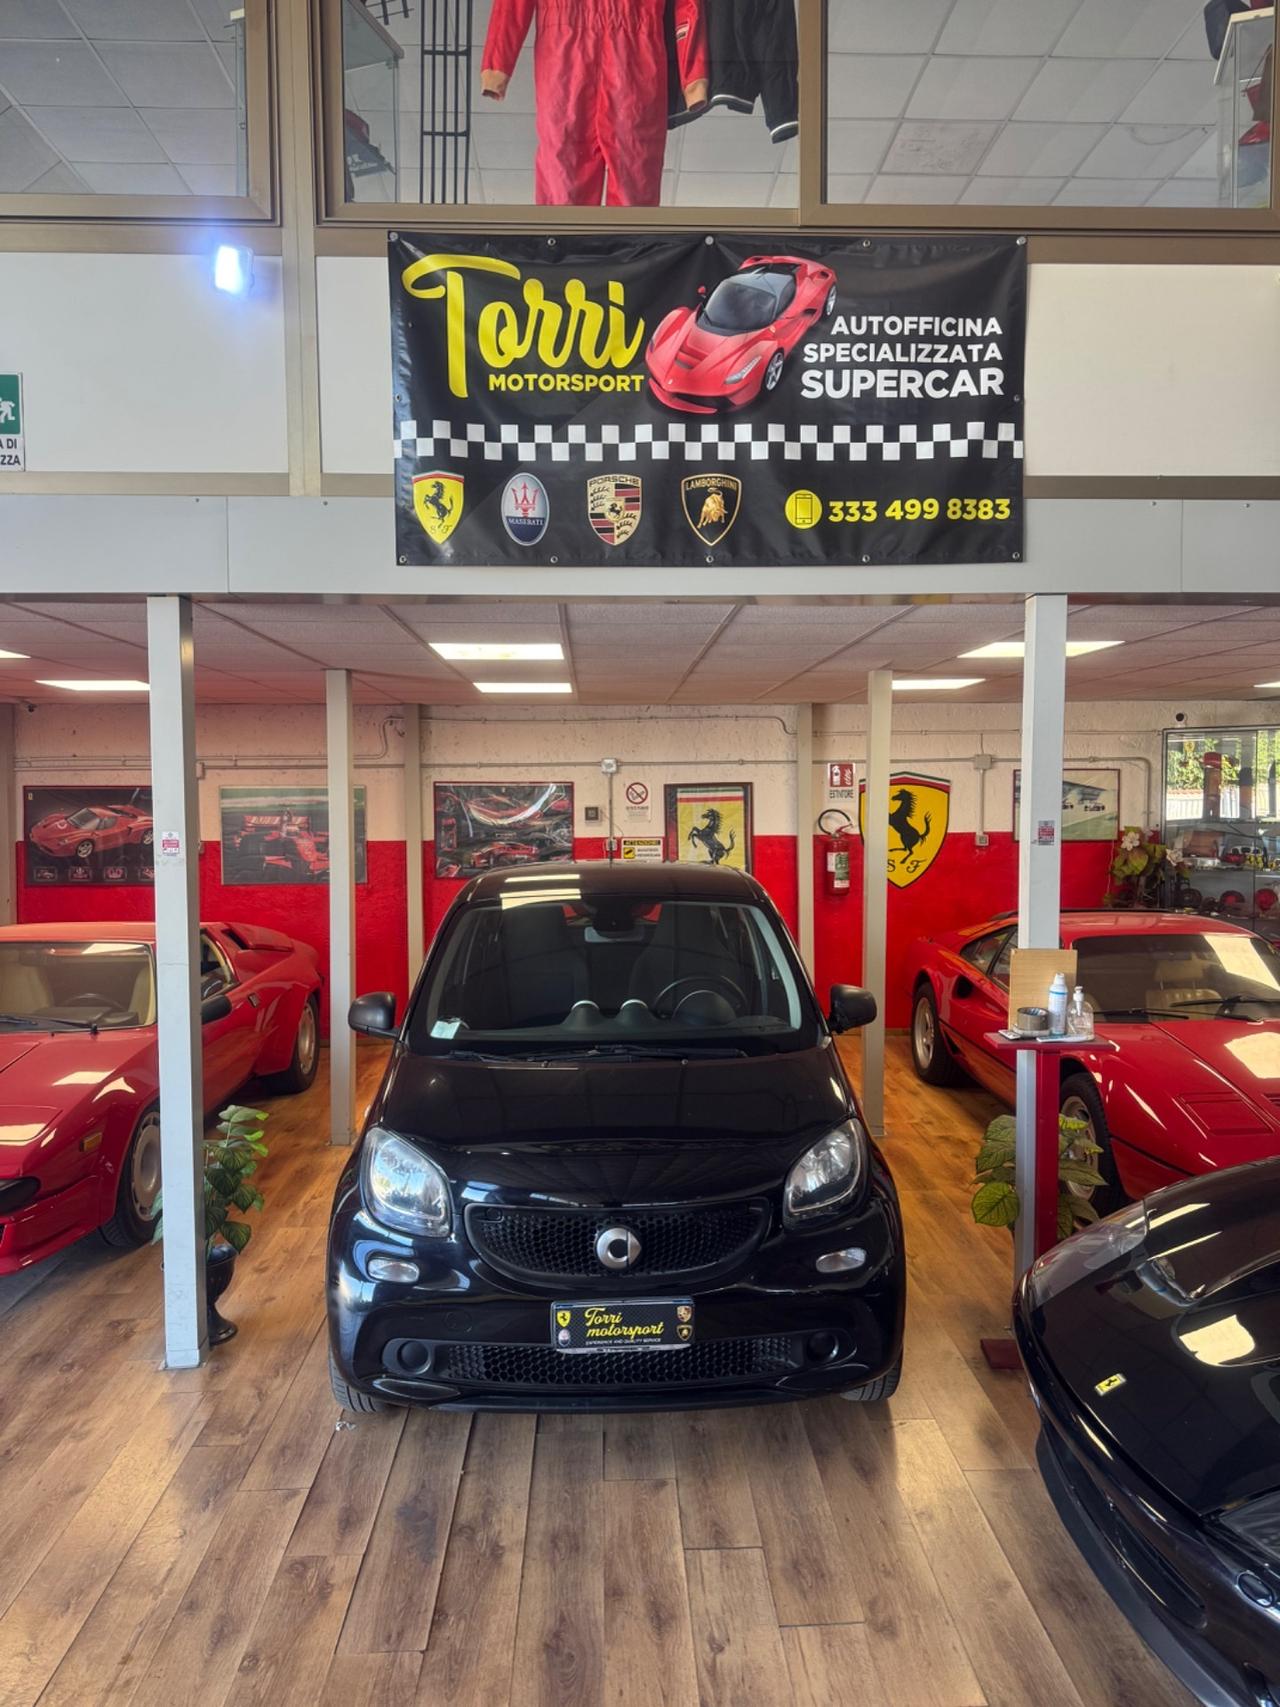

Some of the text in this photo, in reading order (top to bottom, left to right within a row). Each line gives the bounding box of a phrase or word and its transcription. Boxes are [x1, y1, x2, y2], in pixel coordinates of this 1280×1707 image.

[402, 254, 645, 398] Torri
[831, 315, 1003, 337] AUTOFFICINA
[802, 342, 1004, 363] SPECIALIZZATA
[489, 374, 644, 392] MOTORSPORT
[800, 367, 1004, 399] SUPERCAR
[7, 438, 17, 449] DI
[589, 475, 640, 487] PORSCHE
[685, 476, 738, 491] LAMBORGHINI
[828, 498, 1011, 522] 333 499 8383
[508, 518, 544, 526] MASERATI
[584, 1307, 623, 1326] Torri
[586, 1322, 664, 1342] motorsport
